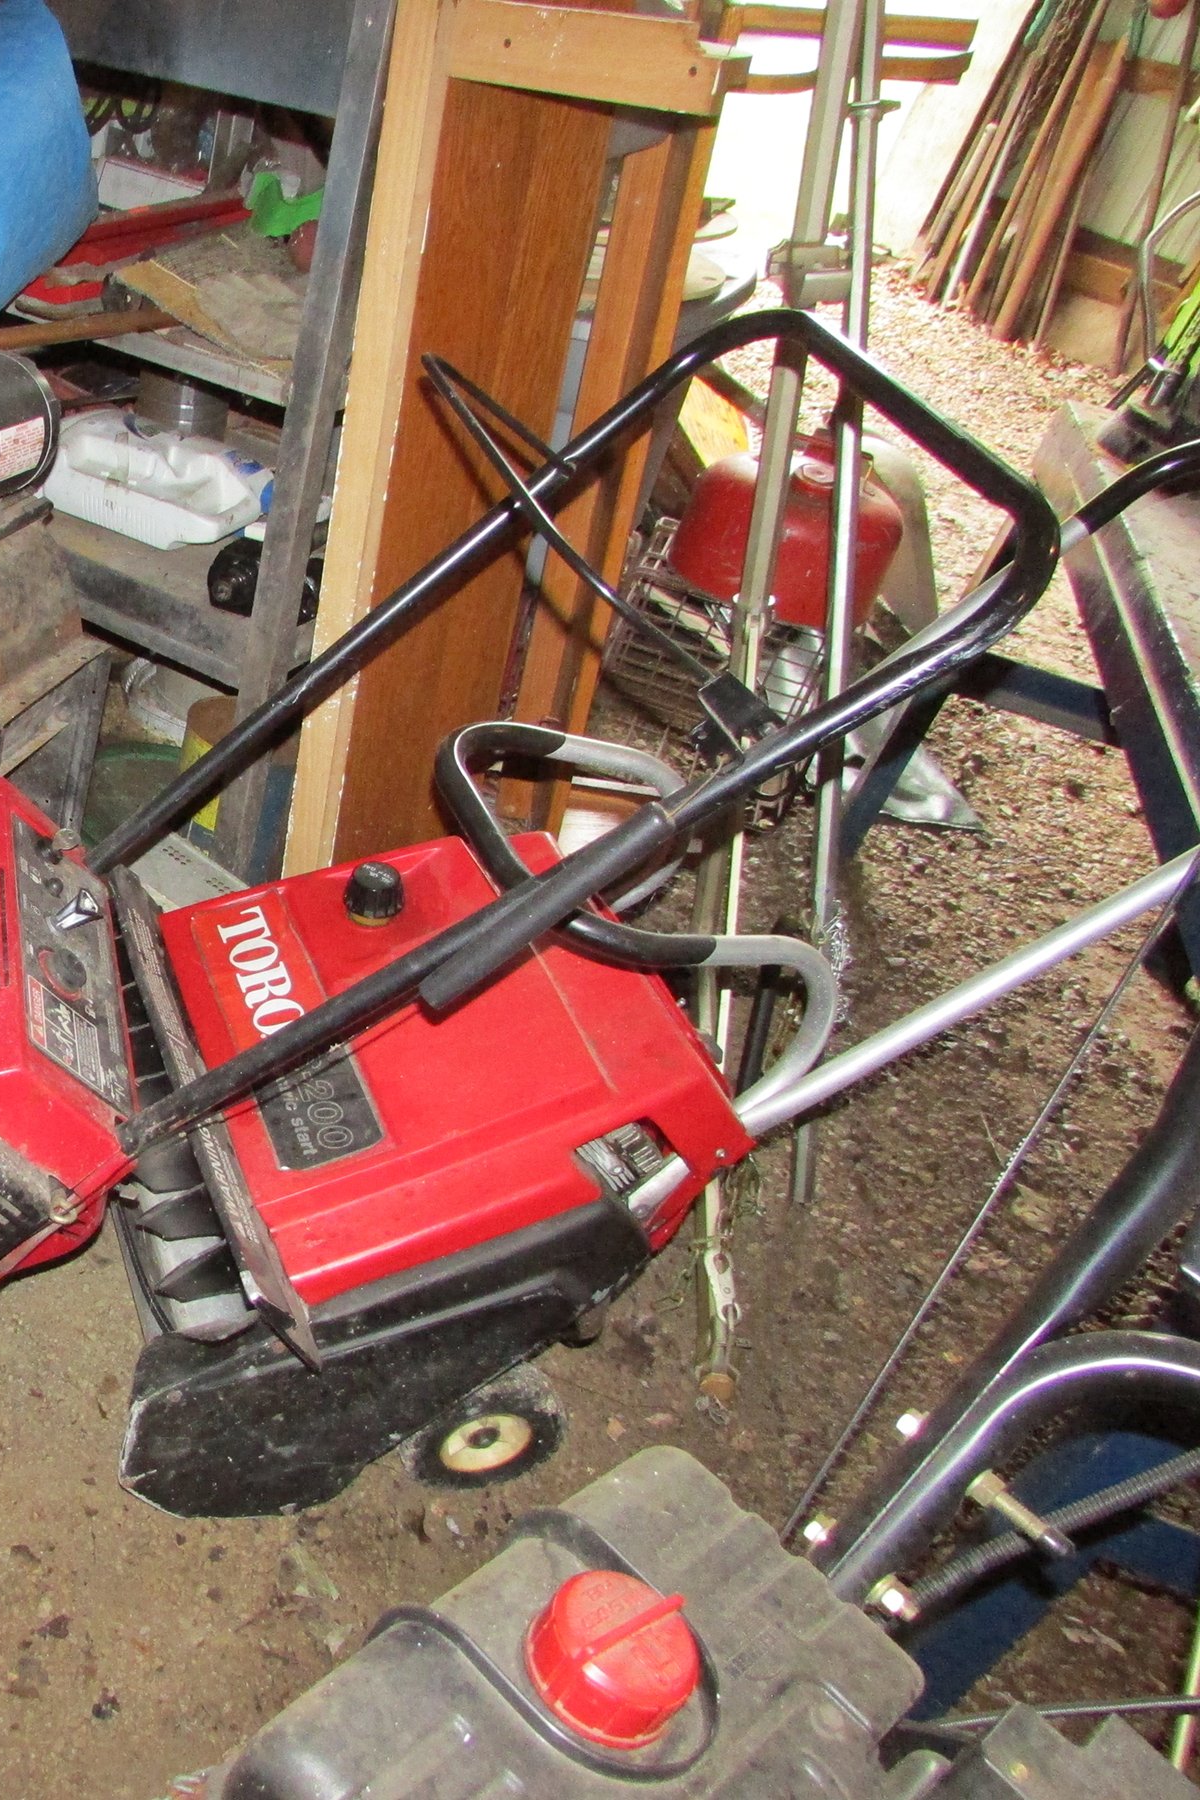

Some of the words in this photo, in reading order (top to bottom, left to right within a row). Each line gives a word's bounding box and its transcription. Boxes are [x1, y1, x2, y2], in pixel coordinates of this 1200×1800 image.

[216, 905, 304, 1035] TORO
[200, 1127, 239, 1217] WARNING
[291, 1117, 318, 1156] start
